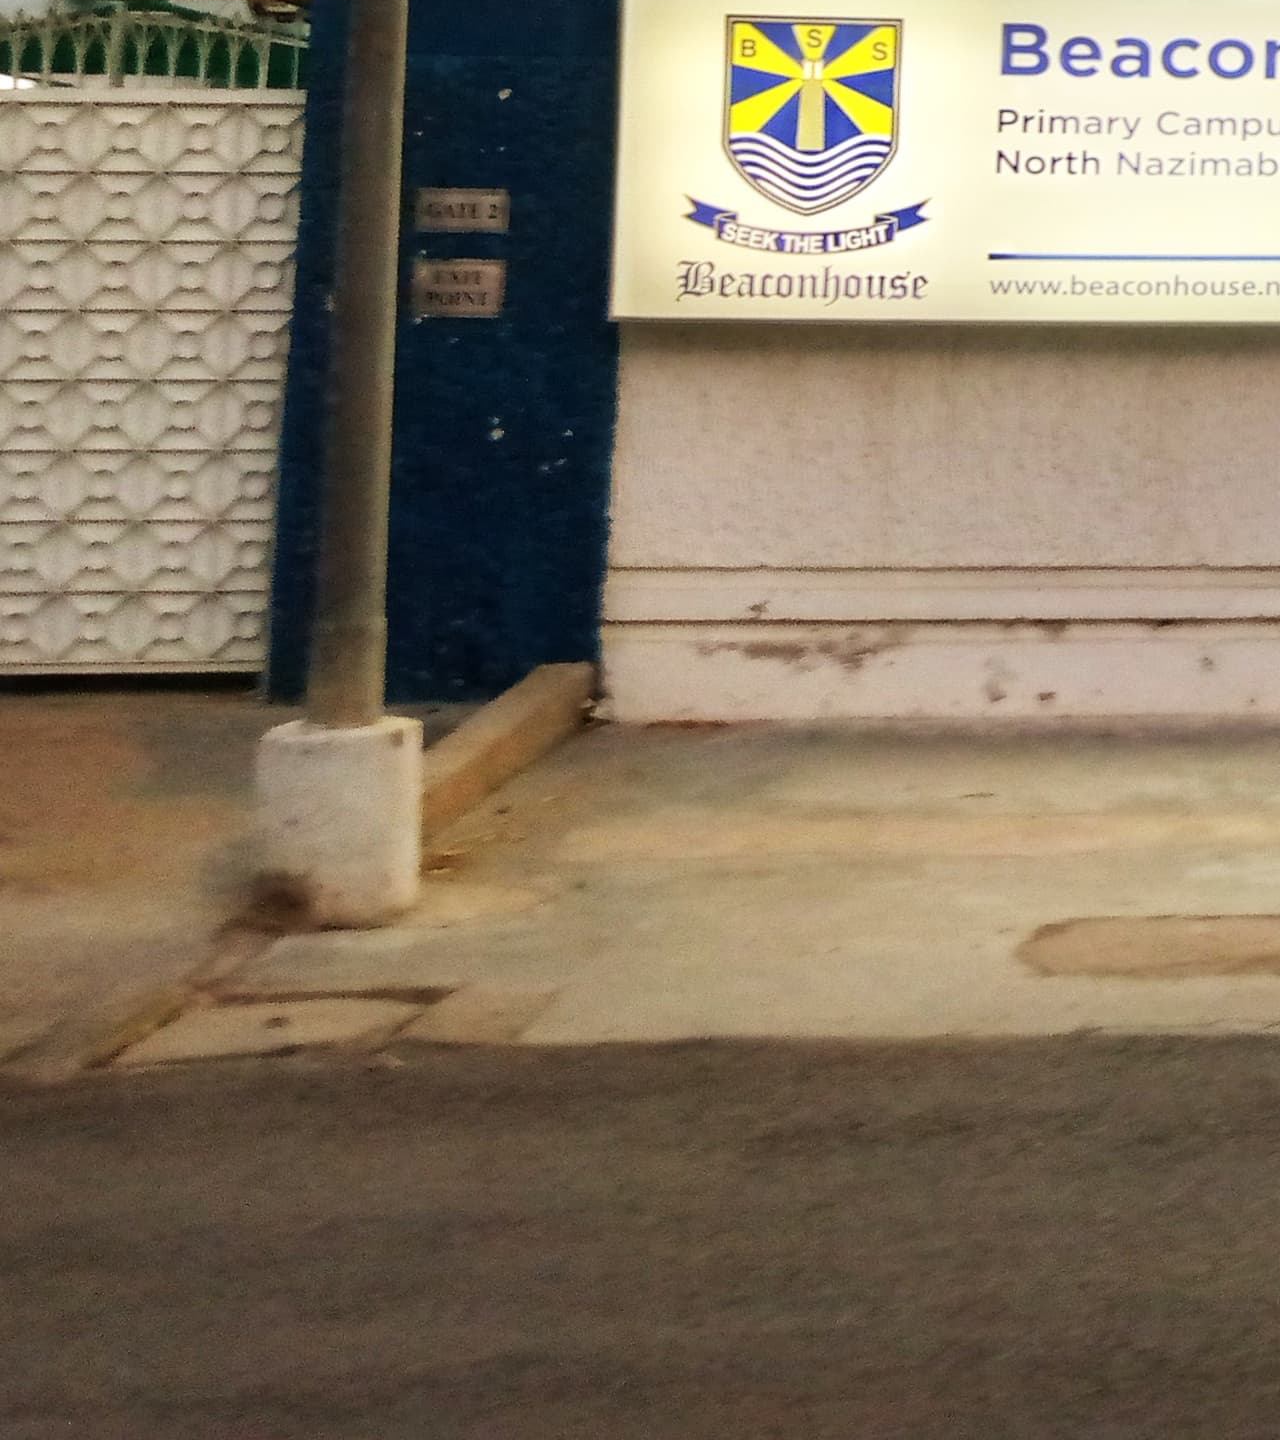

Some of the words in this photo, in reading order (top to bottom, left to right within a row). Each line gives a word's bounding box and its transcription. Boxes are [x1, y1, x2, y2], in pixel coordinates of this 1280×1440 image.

[740, 38, 757, 58] B
[806, 28, 823, 49] S
[871, 41, 888, 62] S
[997, 108, 1141, 142] Primary
[995, 148, 1101, 177] North
[720, 221, 779, 252] SEEK
[780, 233, 825, 253] THE
[827, 224, 893, 252] LIGHT
[675, 259, 930, 306] Beaconhouse
